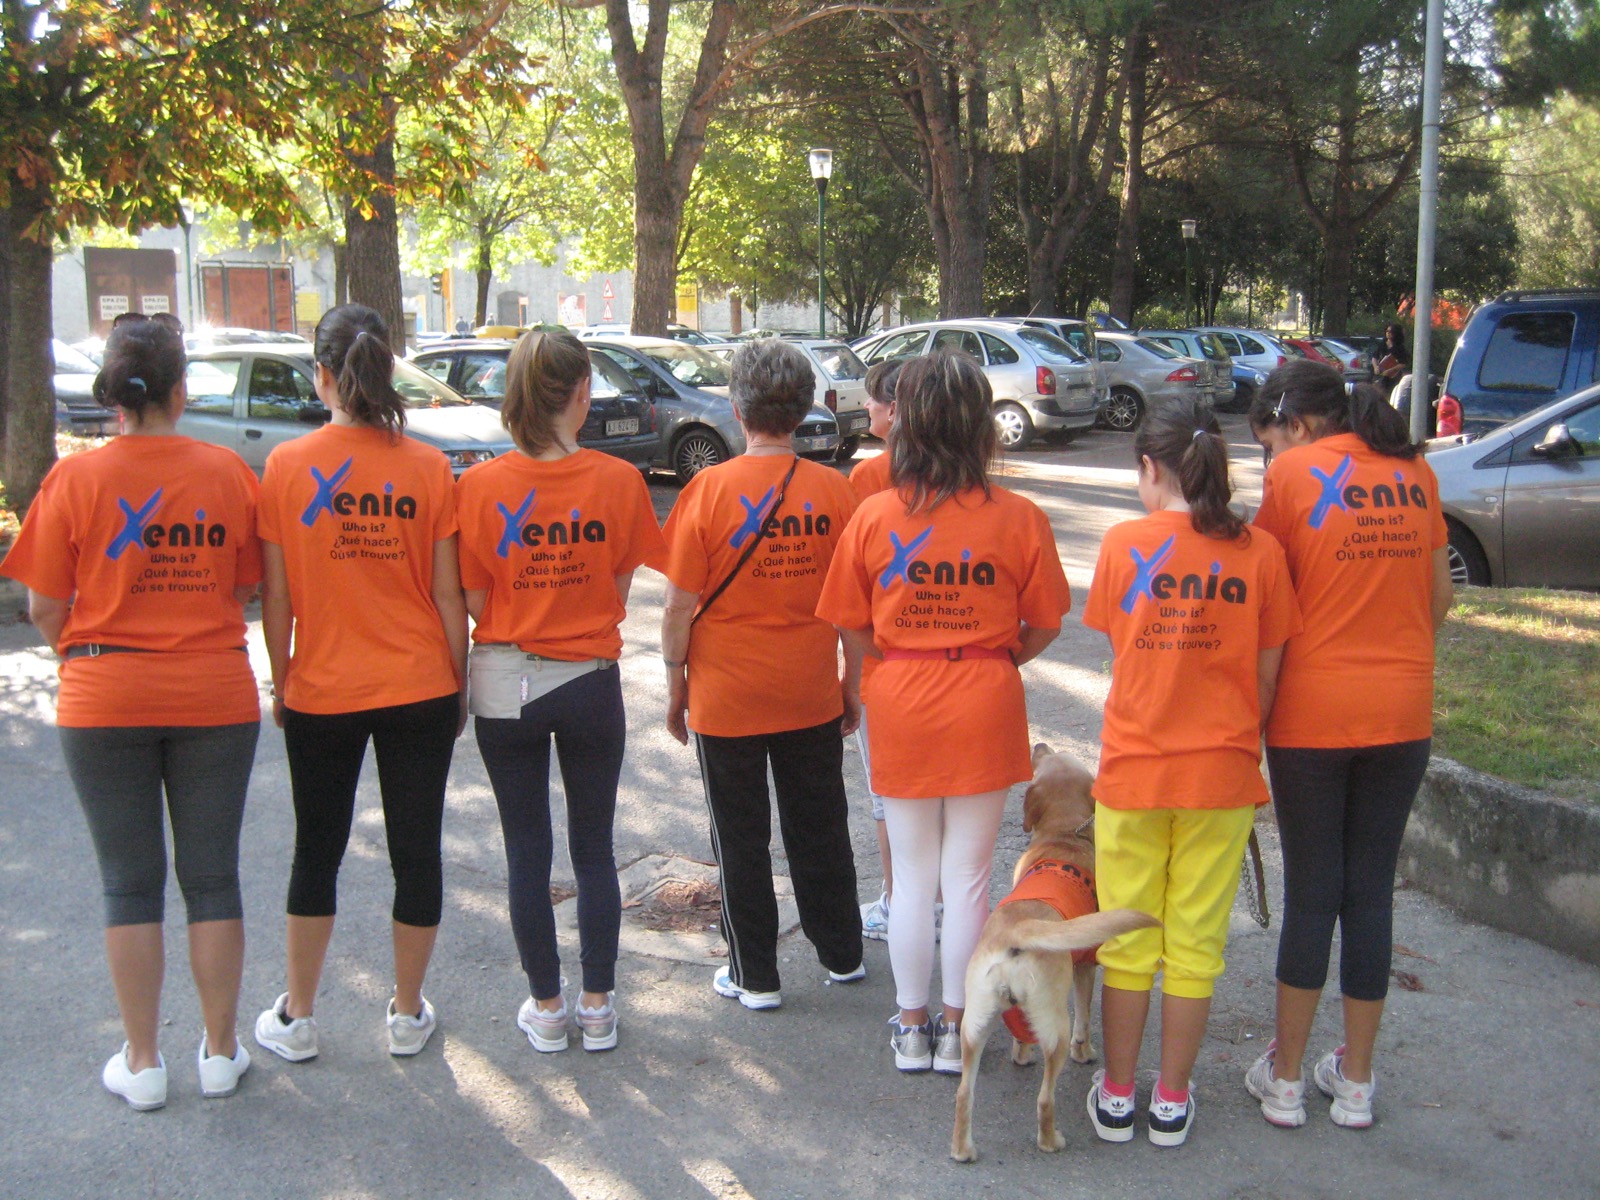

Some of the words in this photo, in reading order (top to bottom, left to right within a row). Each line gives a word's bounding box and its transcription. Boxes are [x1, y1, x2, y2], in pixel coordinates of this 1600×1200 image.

[300, 456, 417, 528] Xenia
[1307, 453, 1428, 530] Xenia
[496, 487, 606, 559] Xenia
[728, 485, 831, 549] Xenia
[1356, 516, 1385, 526] Who
[1389, 515, 1404, 524] is?
[105, 487, 226, 561] Xenia
[342, 522, 367, 532] Who
[370, 523, 386, 533] is?
[363, 537, 399, 547] hace?
[1342, 532, 1378, 547] ¿Qué
[1382, 531, 1418, 541] hace?
[769, 544, 790, 553] Who
[793, 542, 807, 551] is?
[151, 554, 176, 563] Who
[180, 553, 196, 563] is?
[346, 550, 357, 558] se
[360, 550, 406, 560] trouve?
[531, 552, 556, 561] Who
[559, 550, 573, 560] is?
[879, 524, 995, 590] Xenia
[1336, 549, 1355, 561] Où
[1359, 550, 1374, 559] se
[1378, 547, 1422, 558] trouve?
[173, 568, 210, 578] hace?
[553, 562, 585, 575] hace?
[1120, 533, 1247, 615] Xenia
[150, 584, 164, 592] se
[168, 582, 216, 592] trouve?
[533, 580, 546, 588] se
[550, 574, 591, 588] trouve?
[915, 591, 941, 601] Who
[945, 591, 960, 601] is?
[901, 604, 933, 616] ¿Qué
[937, 605, 974, 616] hace?
[1160, 607, 1186, 618] Who
[1191, 607, 1205, 618] is?
[915, 620, 929, 629] se
[933, 619, 980, 631] trouve?
[1143, 622, 1178, 636] ¿Qué
[1182, 623, 1217, 635] hace?
[1159, 641, 1173, 650] se
[1177, 639, 1221, 650] trouve?
